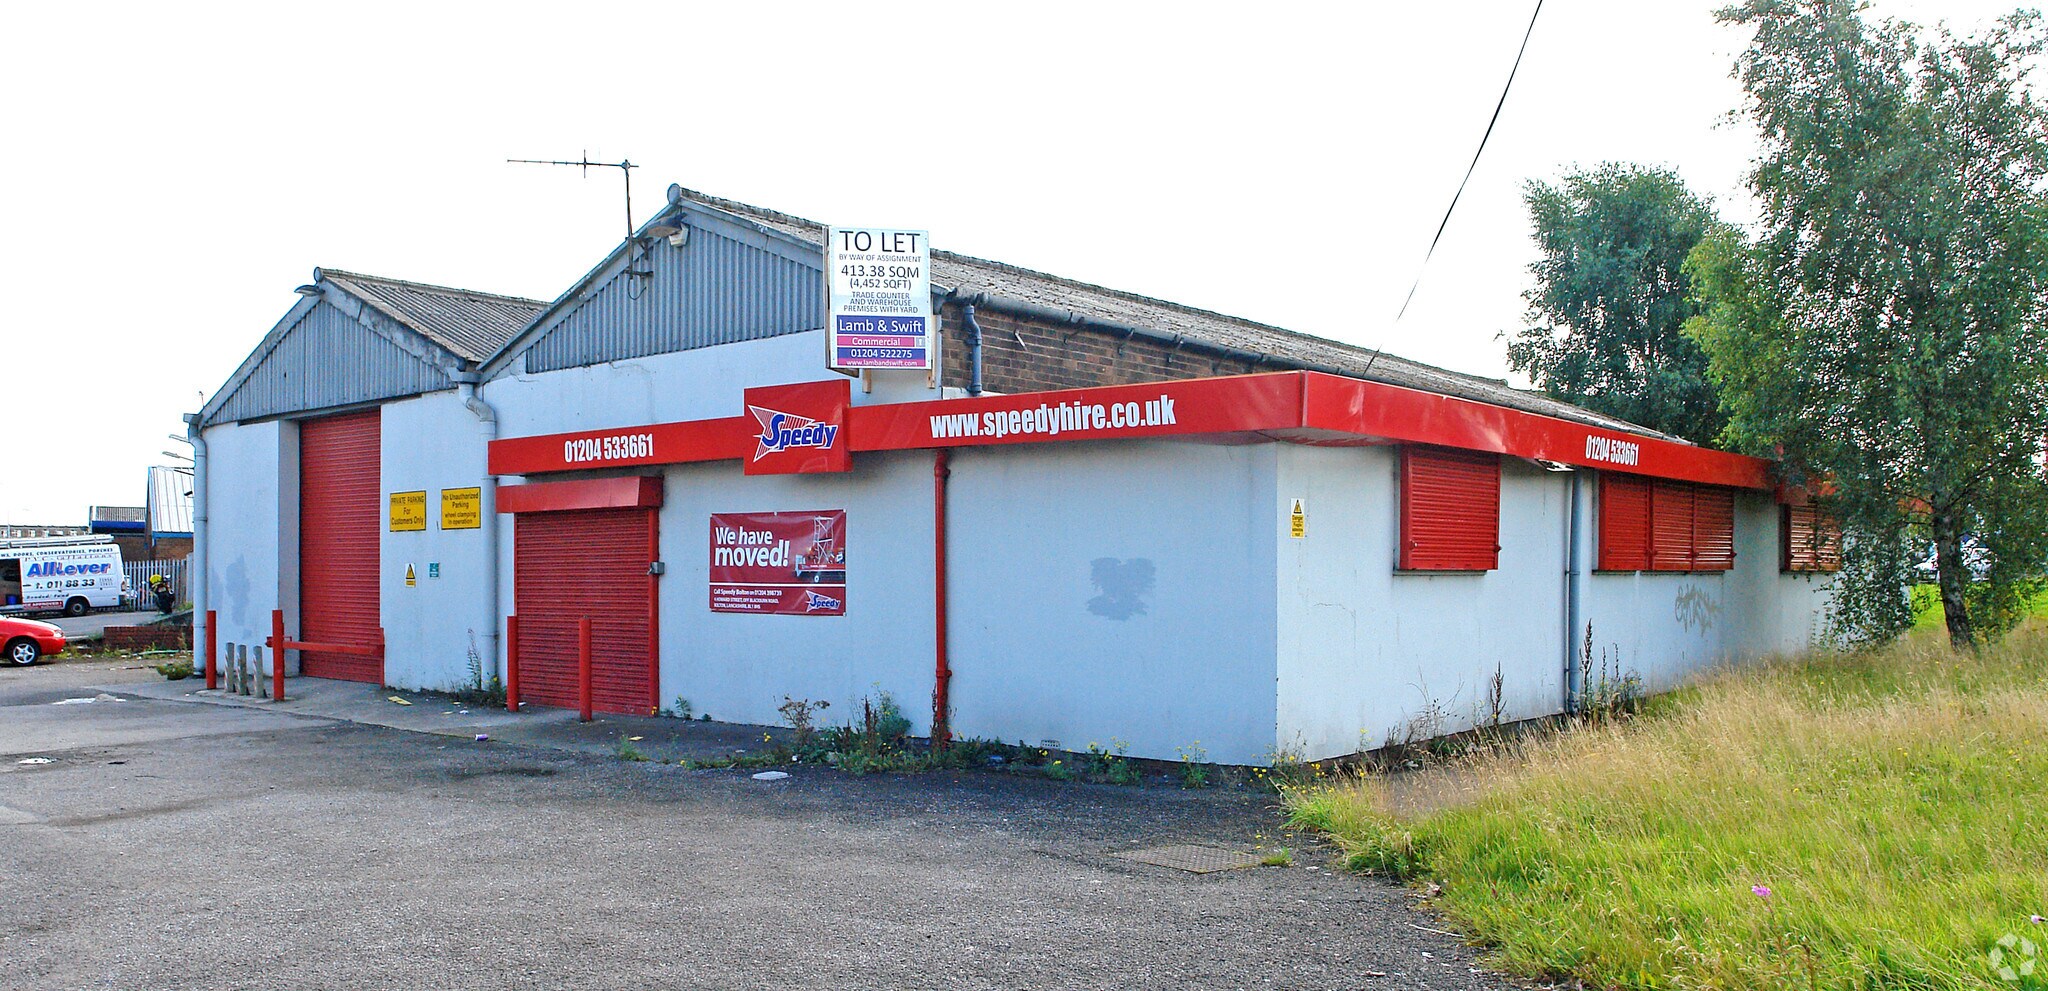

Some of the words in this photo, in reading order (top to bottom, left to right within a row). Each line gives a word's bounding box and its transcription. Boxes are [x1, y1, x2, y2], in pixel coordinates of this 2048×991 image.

[839, 230, 872, 251] TO
[881, 232, 920, 253] LET
[877, 255, 921, 263] ASSIGNMENT
[841, 265, 885, 277] 413.38
[889, 266, 919, 279] SQM
[850, 279, 881, 290] (4,452
[883, 279, 912, 291] SQFT)
[852, 291, 875, 299] TRADE
[876, 292, 910, 300] COUNTER
[843, 305, 878, 313] PREMISES
[900, 306, 918, 314] YARD
[867, 299, 912, 307] WAREHOUSE
[839, 319, 874, 332] Lamb
[877, 320, 888, 333] &
[891, 320, 923, 333] Swift
[852, 337, 901, 346] Commercial
[851, 349, 878, 358] 01204
[881, 350, 913, 359] 522275
[846, 359, 918, 367] www.lambandswift.com
[930, 394, 1177, 438] www.speedyhire.co.uk
[762, 413, 838, 451] Speedy
[564, 440, 601, 463] 01204
[604, 433, 654, 460] 533661
[1586, 434, 1610, 461] 01204
[1610, 439, 1639, 466] 533661
[715, 527, 739, 545] We
[739, 526, 773, 545] have
[714, 539, 790, 567] moved!
[81, 579, 95, 587] 33
[810, 595, 840, 609] Speedy
